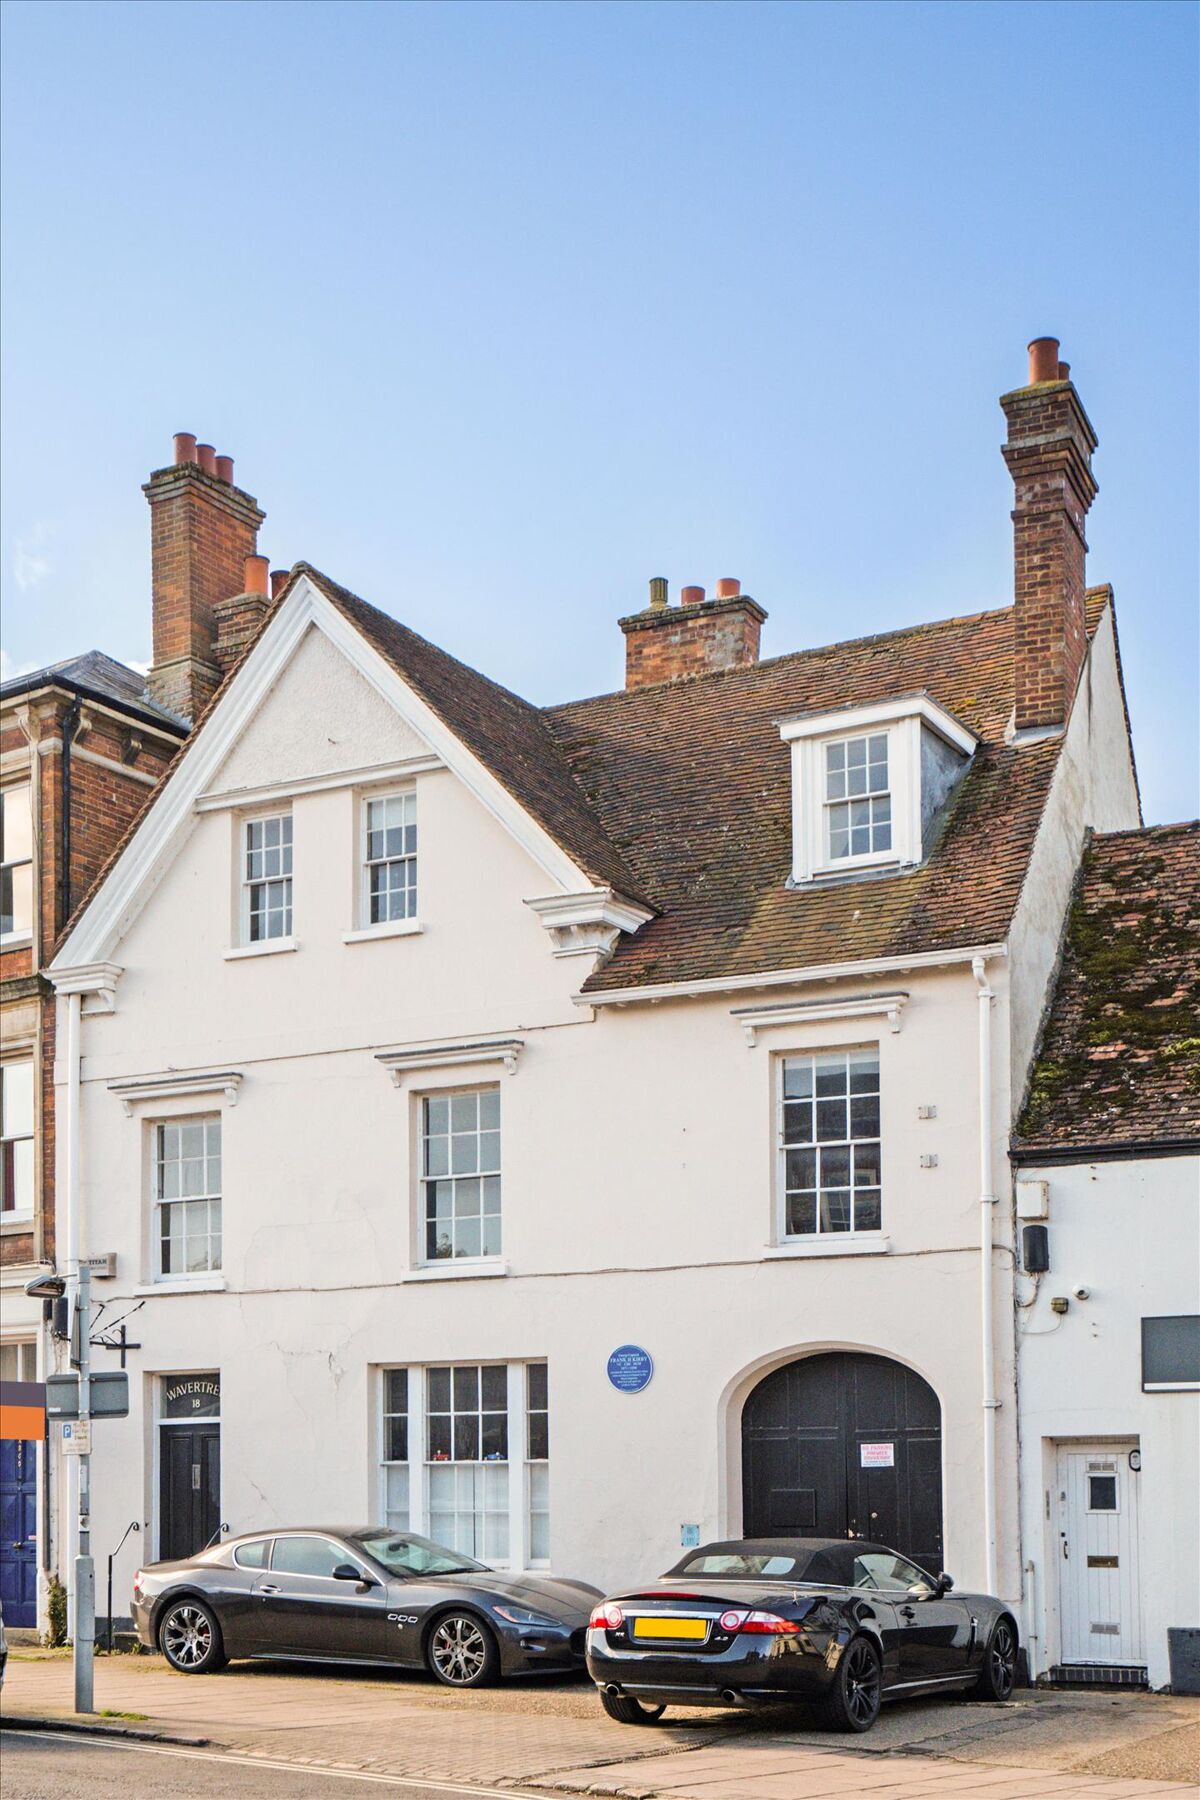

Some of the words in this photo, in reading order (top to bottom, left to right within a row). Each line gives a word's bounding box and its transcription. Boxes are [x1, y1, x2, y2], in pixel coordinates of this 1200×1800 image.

[166, 1381, 220, 1401] WAVERTRE
[192, 1399, 201, 1409] 18
[64, 1426, 71, 1438] P
